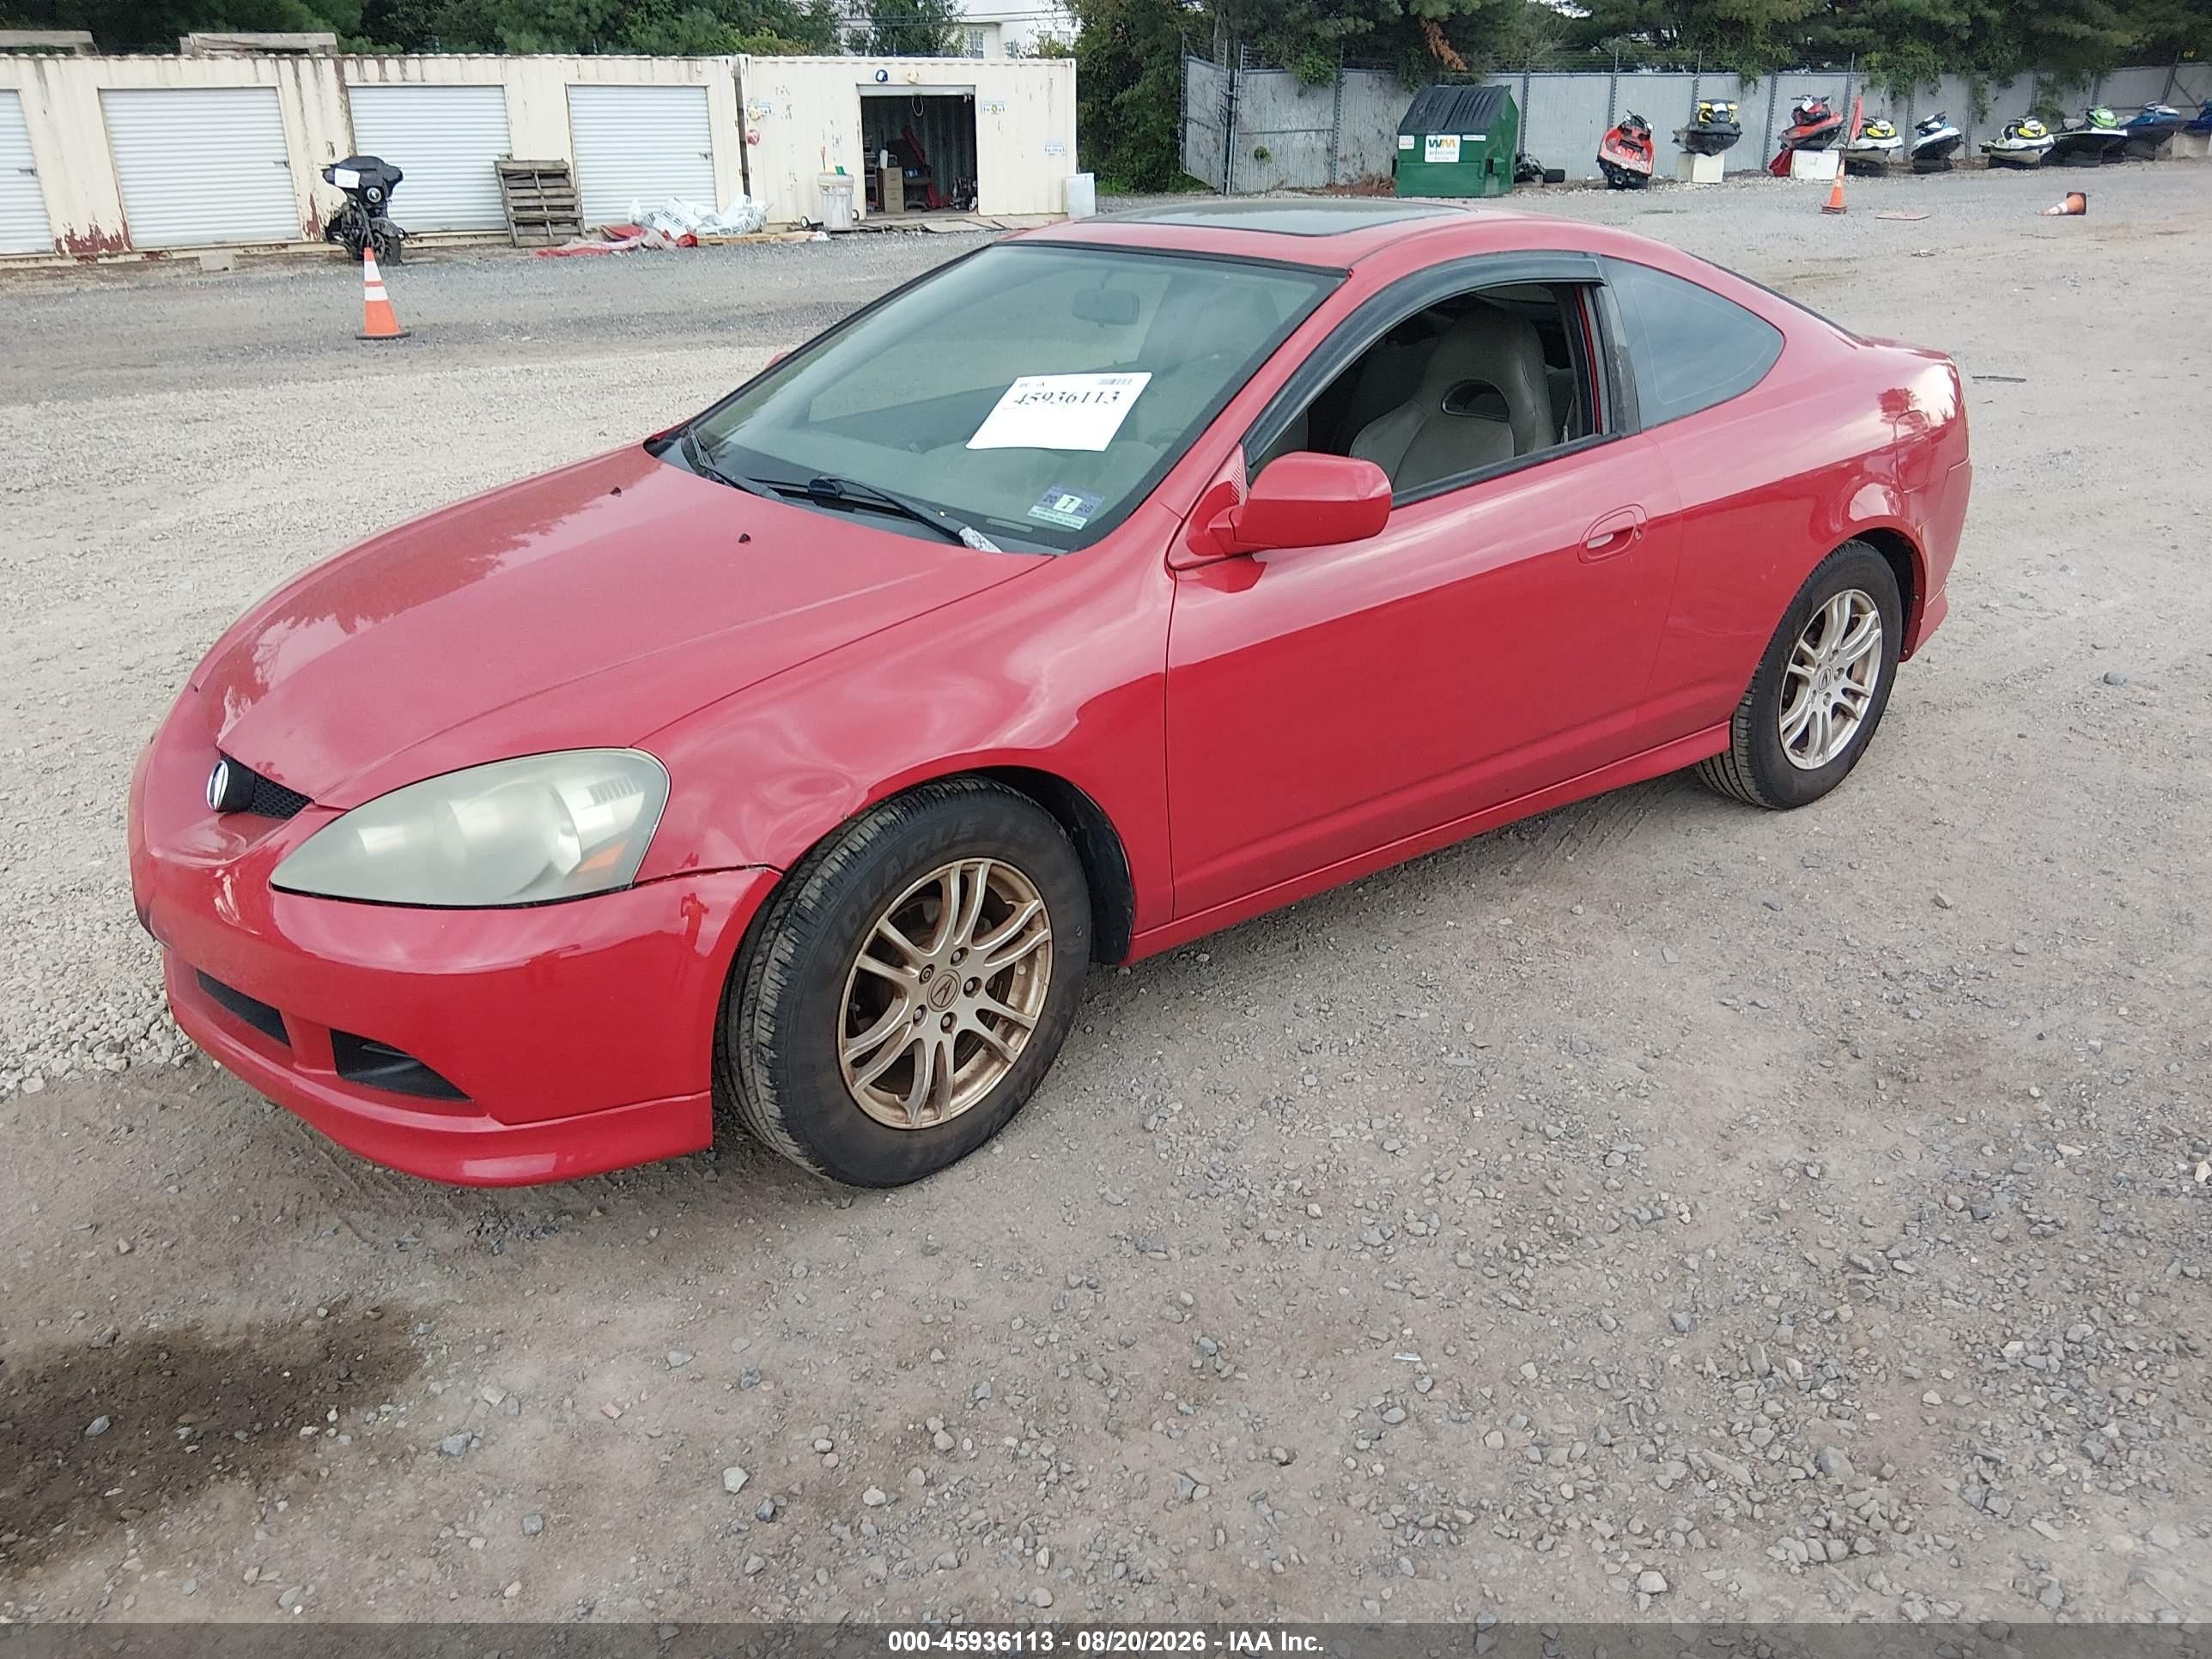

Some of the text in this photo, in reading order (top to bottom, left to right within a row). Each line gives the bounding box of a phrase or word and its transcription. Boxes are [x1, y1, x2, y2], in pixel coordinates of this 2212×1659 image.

[1428, 138, 1456, 149] WM
[1014, 391, 1121, 405] 45936113
[1061, 497, 1075, 509] 7
